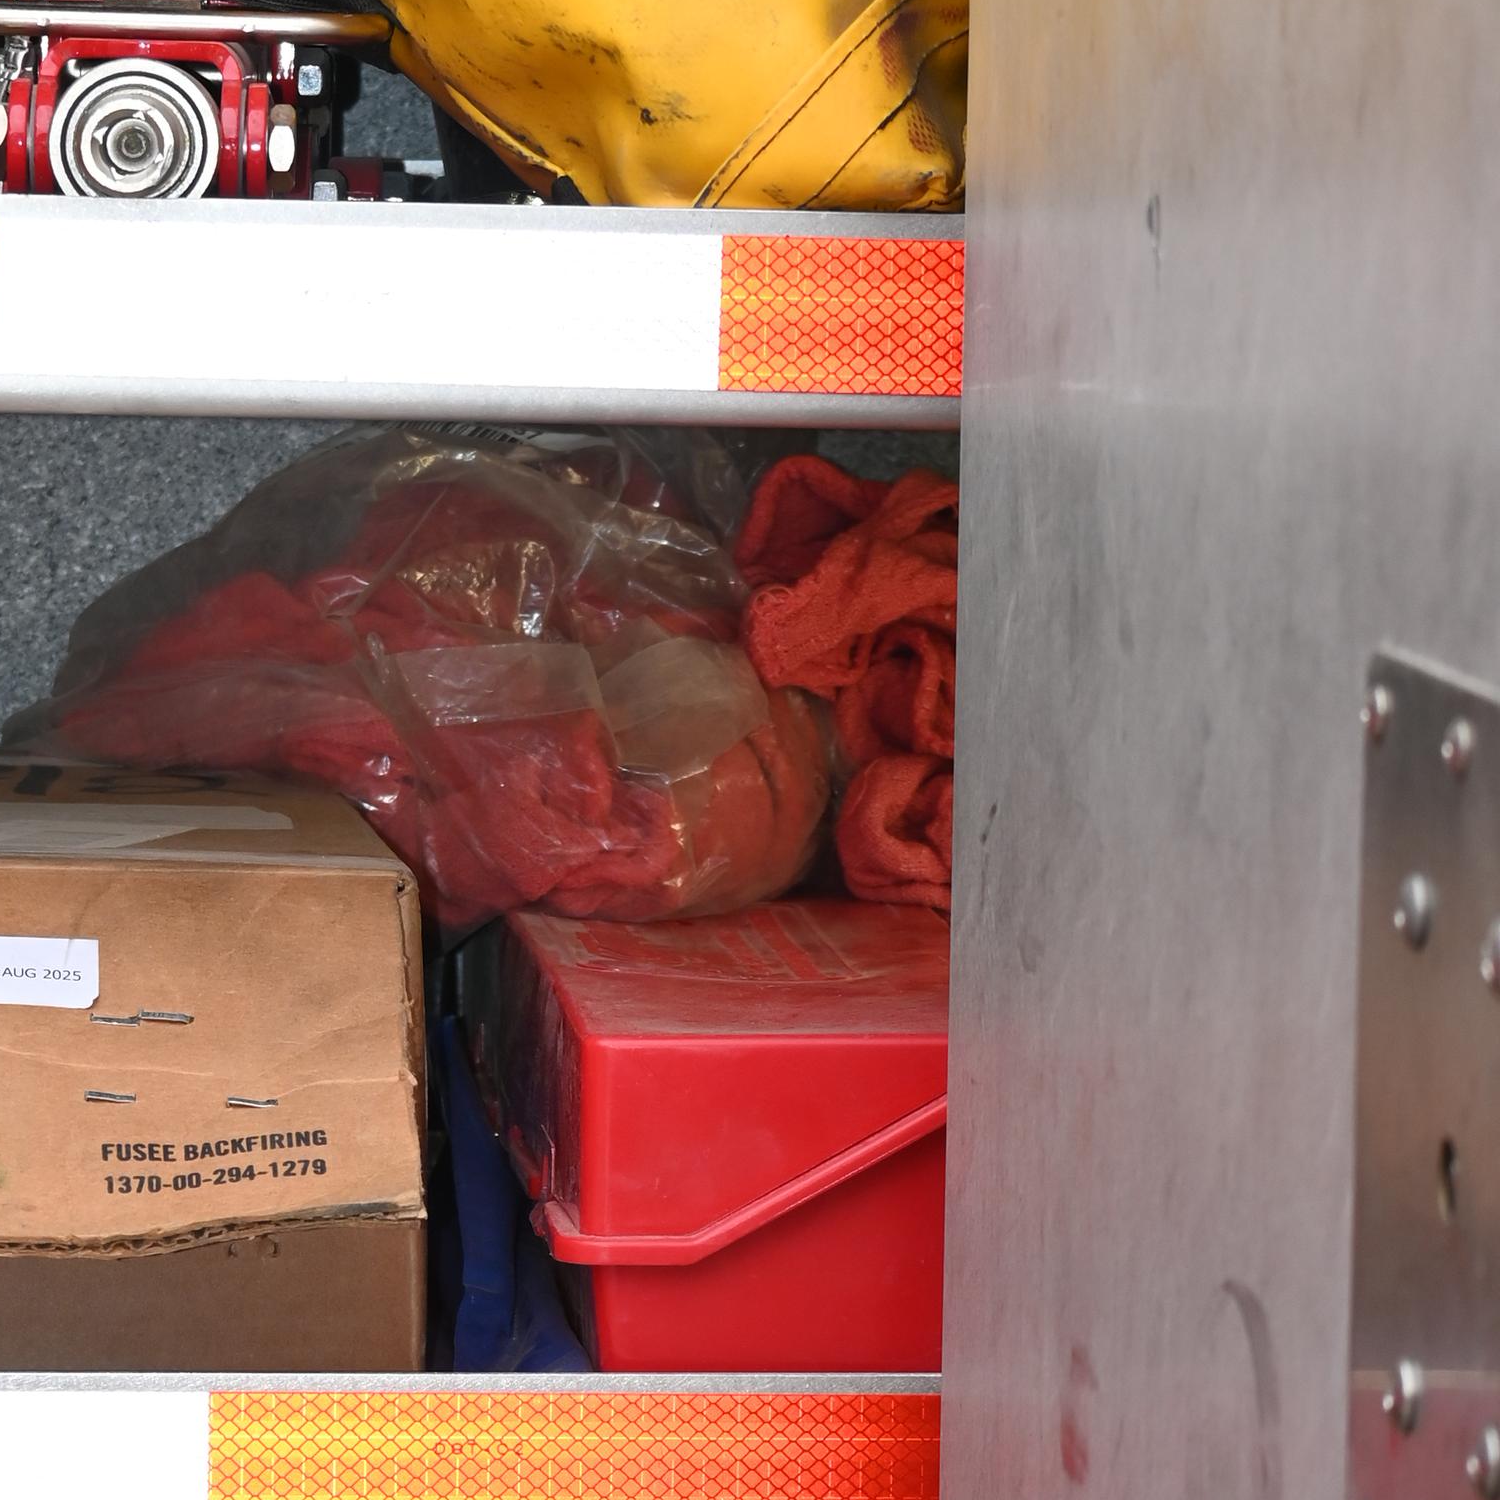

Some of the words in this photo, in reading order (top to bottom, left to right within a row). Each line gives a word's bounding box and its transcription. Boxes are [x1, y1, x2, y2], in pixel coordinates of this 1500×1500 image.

[43, 967, 83, 983] 2025
[101, 1142, 176, 1163] FUSEE
[183, 1129, 328, 1162] BACKFIRING
[104, 1158, 328, 1195] 1370-00-294-1279
